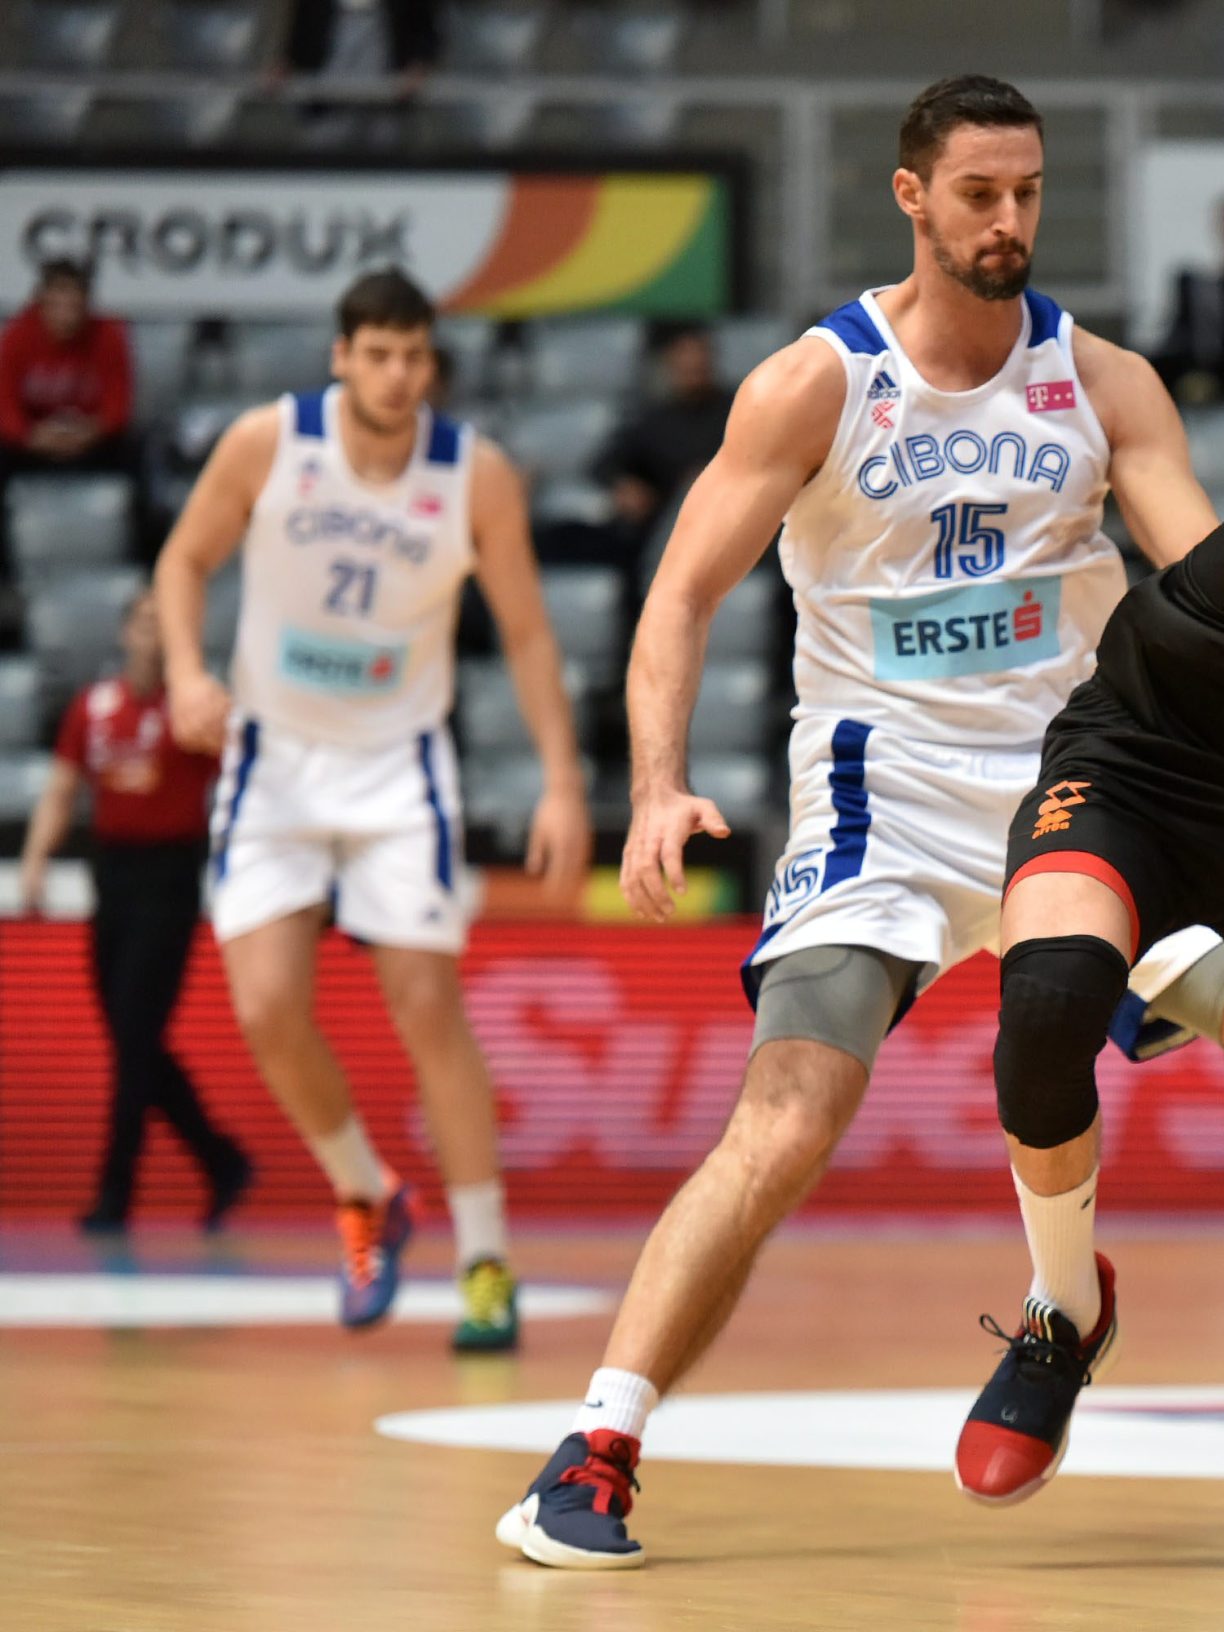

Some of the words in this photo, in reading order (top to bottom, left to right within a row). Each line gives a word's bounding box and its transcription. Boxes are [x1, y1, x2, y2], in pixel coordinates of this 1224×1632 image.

[857, 429, 1071, 500] CIBONA
[930, 502, 1009, 579] 15
[325, 560, 376, 618] 21
[892, 610, 1010, 657] ERSTE
